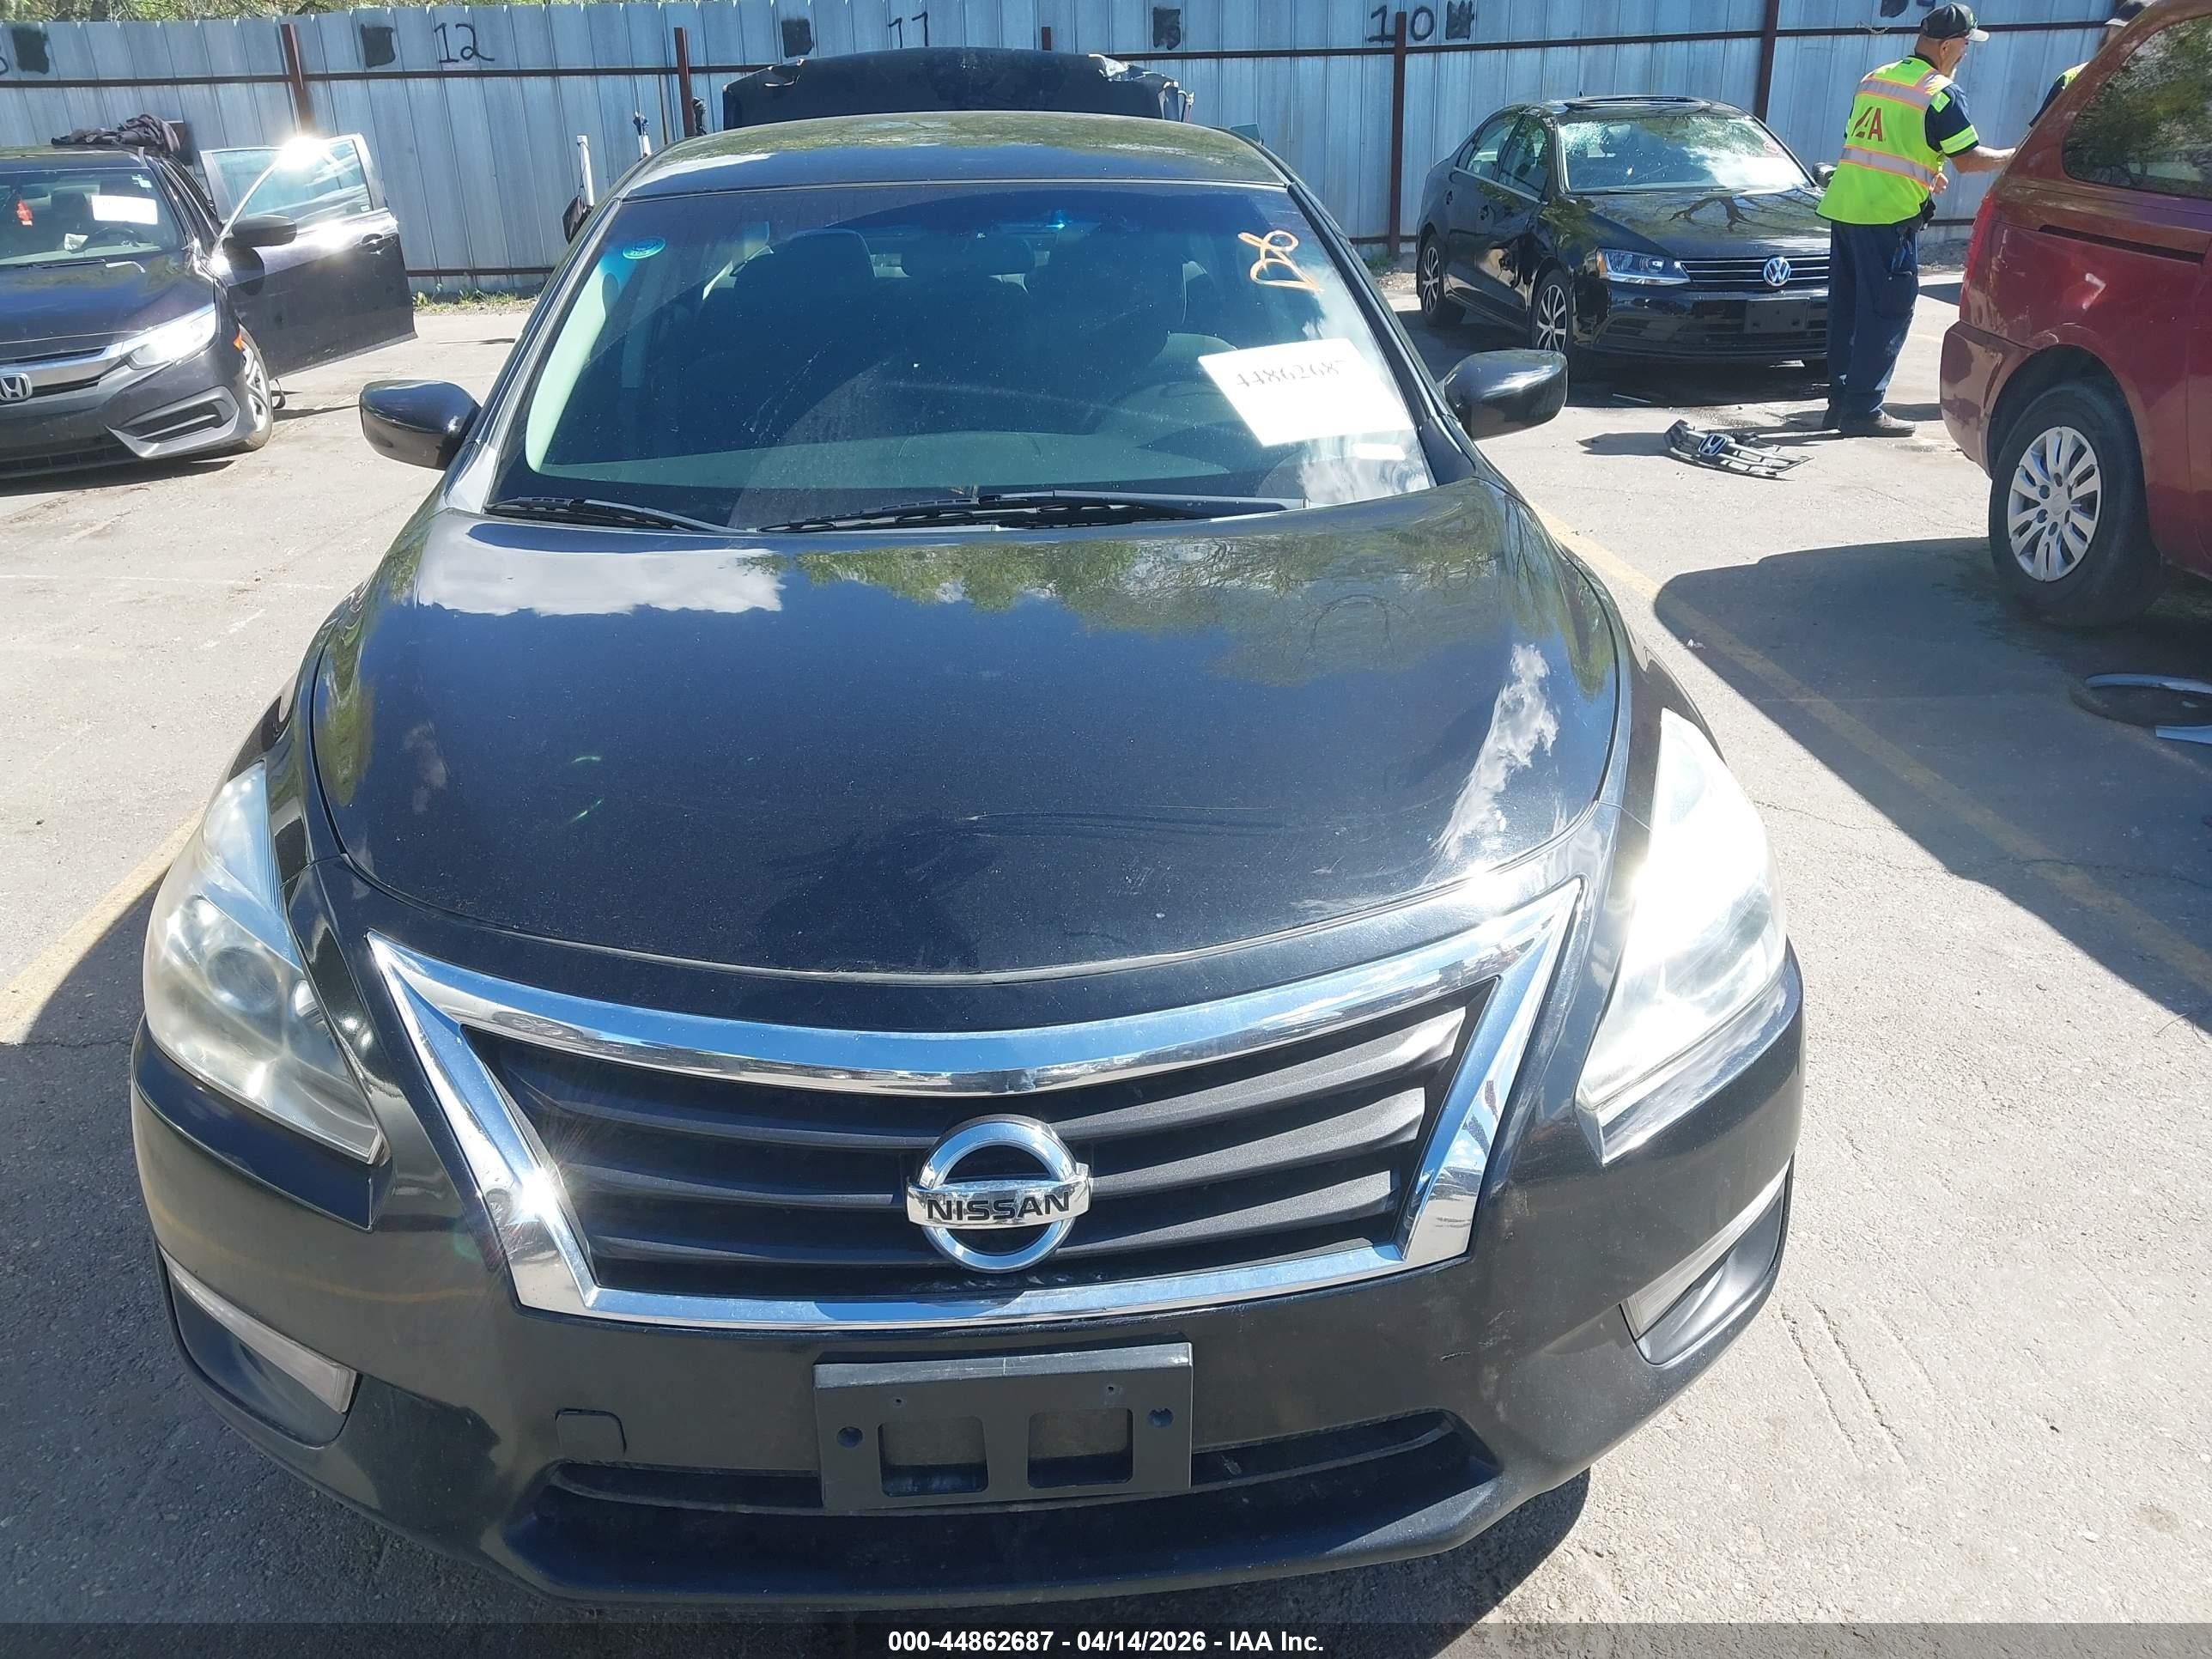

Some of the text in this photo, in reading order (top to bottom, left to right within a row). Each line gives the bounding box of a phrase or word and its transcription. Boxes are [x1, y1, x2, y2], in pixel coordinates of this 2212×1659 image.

[1366, 4, 1435, 42] 10
[434, 22, 495, 64] 12
[926, 1191, 1070, 1221] NISSAN
